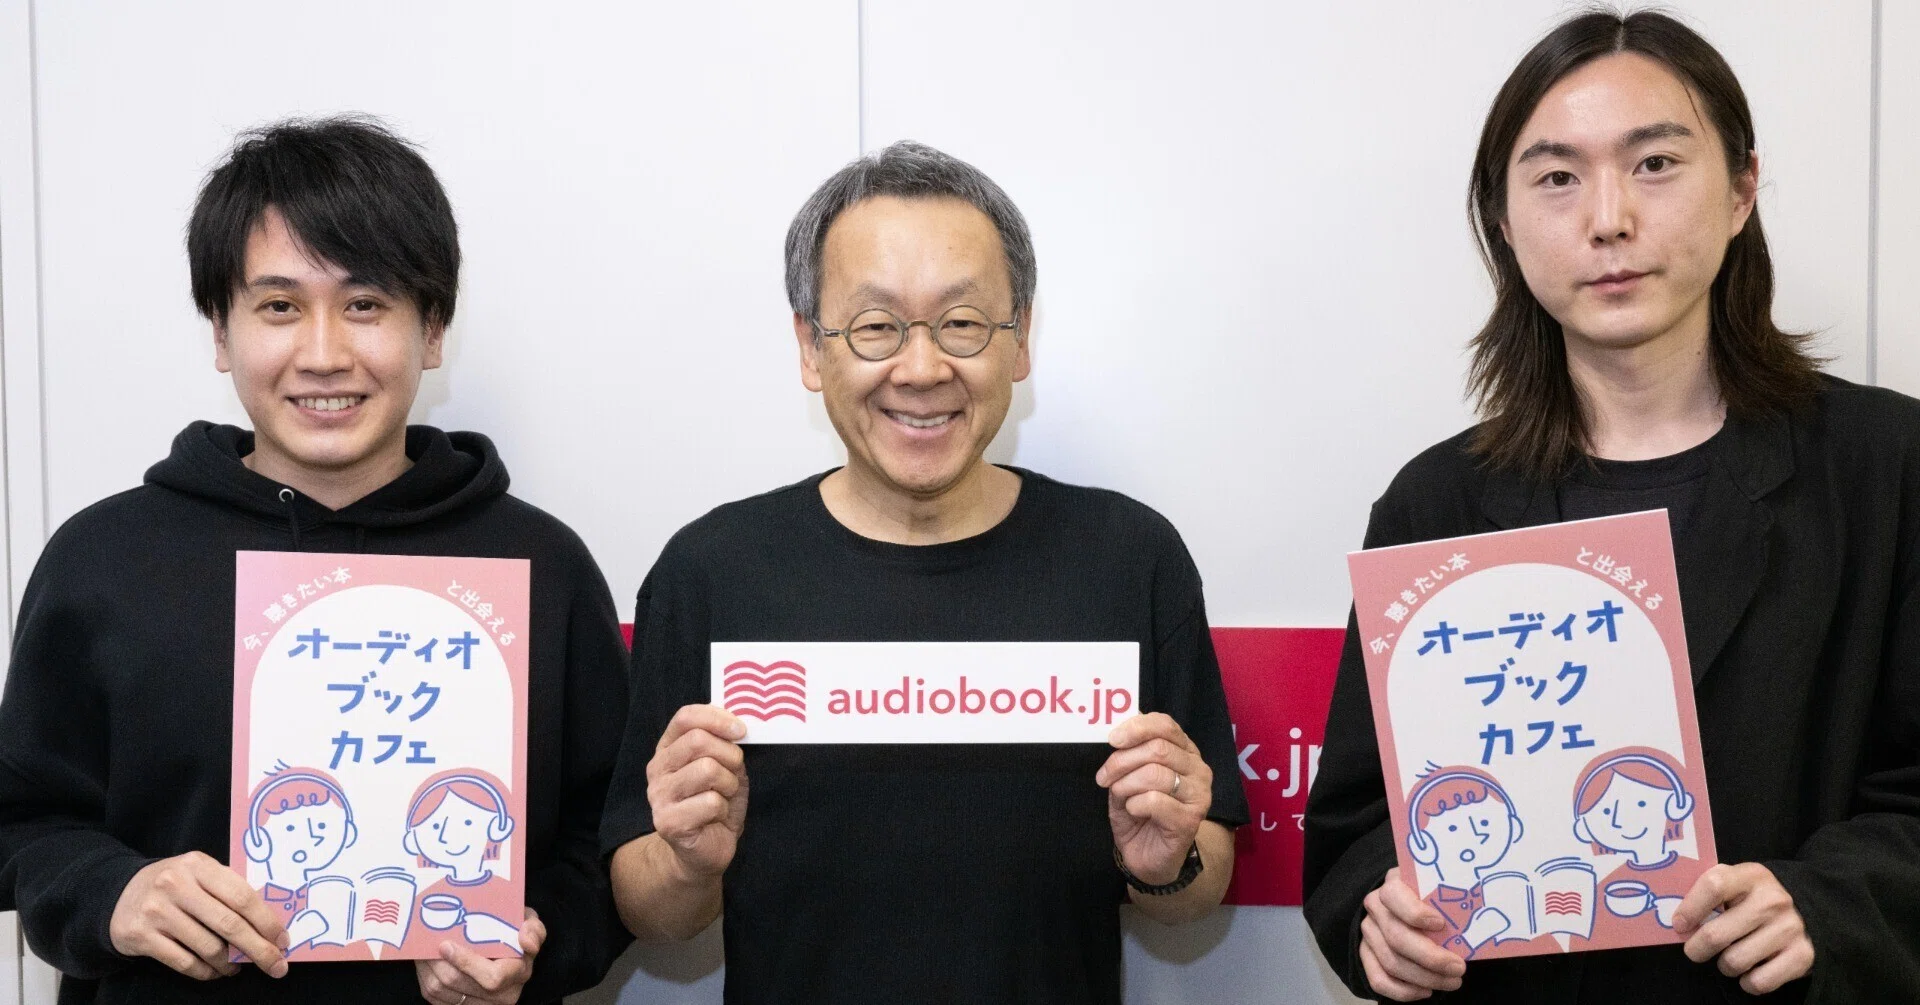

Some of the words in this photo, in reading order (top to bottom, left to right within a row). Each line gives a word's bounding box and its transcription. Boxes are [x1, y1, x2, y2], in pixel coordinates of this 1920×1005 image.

[1575, 547, 1663, 611] と出会える
[446, 579, 516, 647] と出会える
[1417, 600, 1624, 656] オーディオ
[288, 628, 480, 669] オーディオ
[327, 670, 441, 722] ブック
[827, 676, 1132, 724] audiobook.jp
[1464, 657, 1588, 706] ブック
[329, 730, 436, 770] カフェ
[1479, 720, 1595, 765] カフェ
